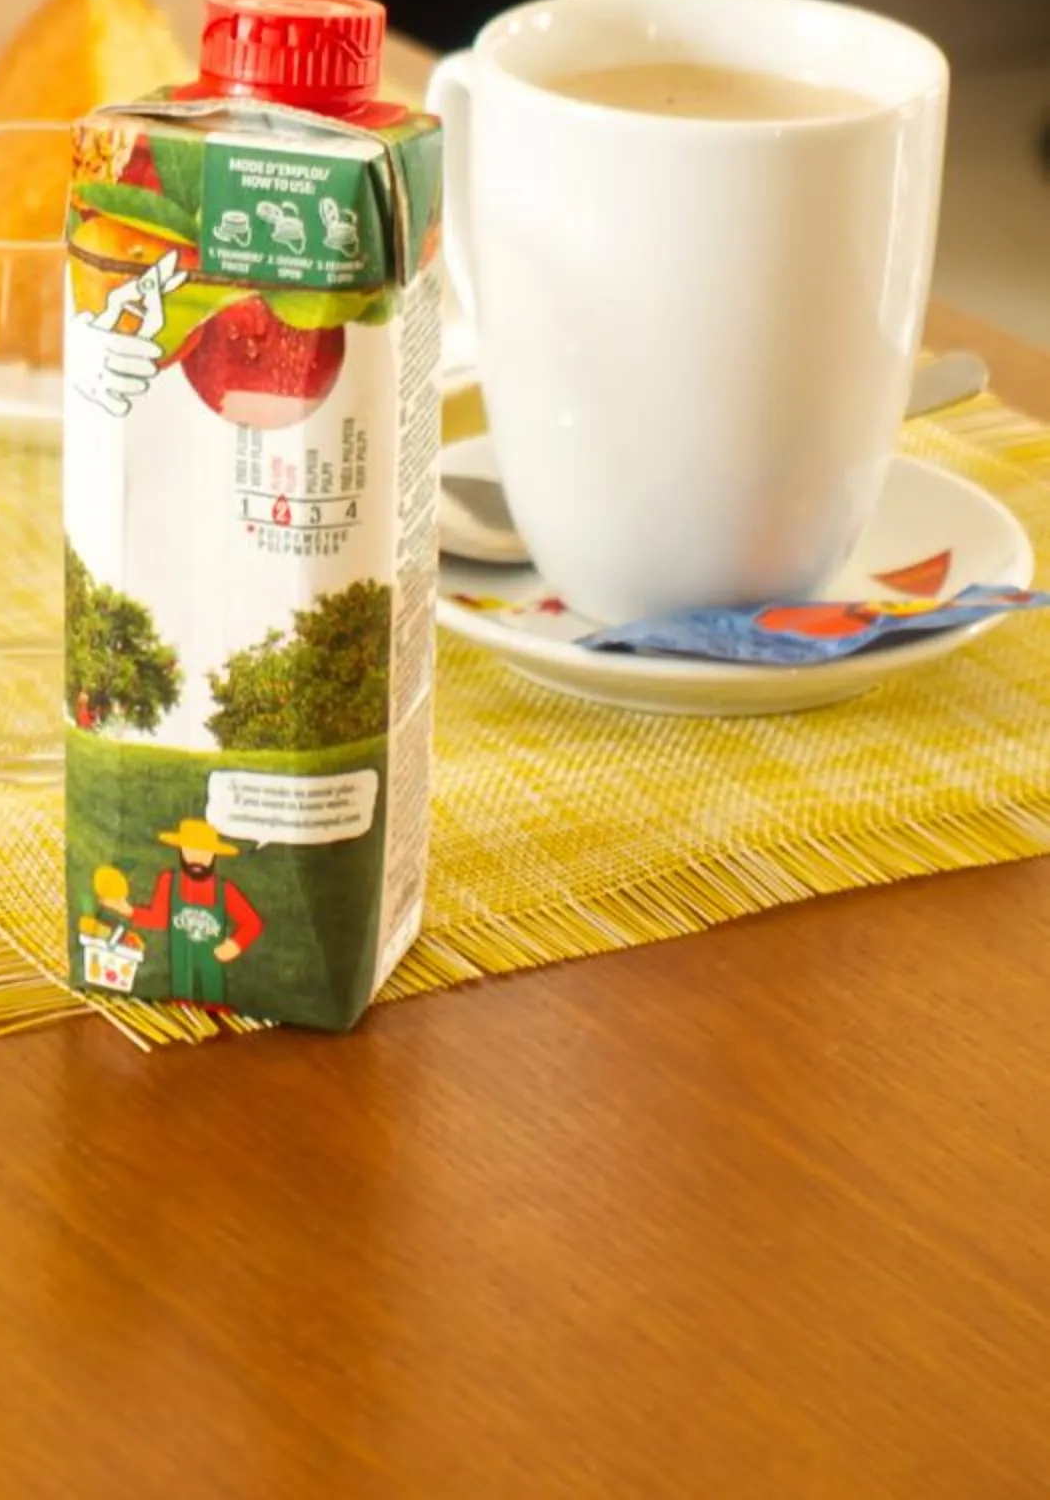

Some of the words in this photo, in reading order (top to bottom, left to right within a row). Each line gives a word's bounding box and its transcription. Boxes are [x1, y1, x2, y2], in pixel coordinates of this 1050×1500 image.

[229, 158, 267, 174] MODE
[241, 175, 273, 190] HOW
[273, 179, 289, 192] TO
[309, 505, 321, 525] 3
[345, 499, 357, 519] 4
